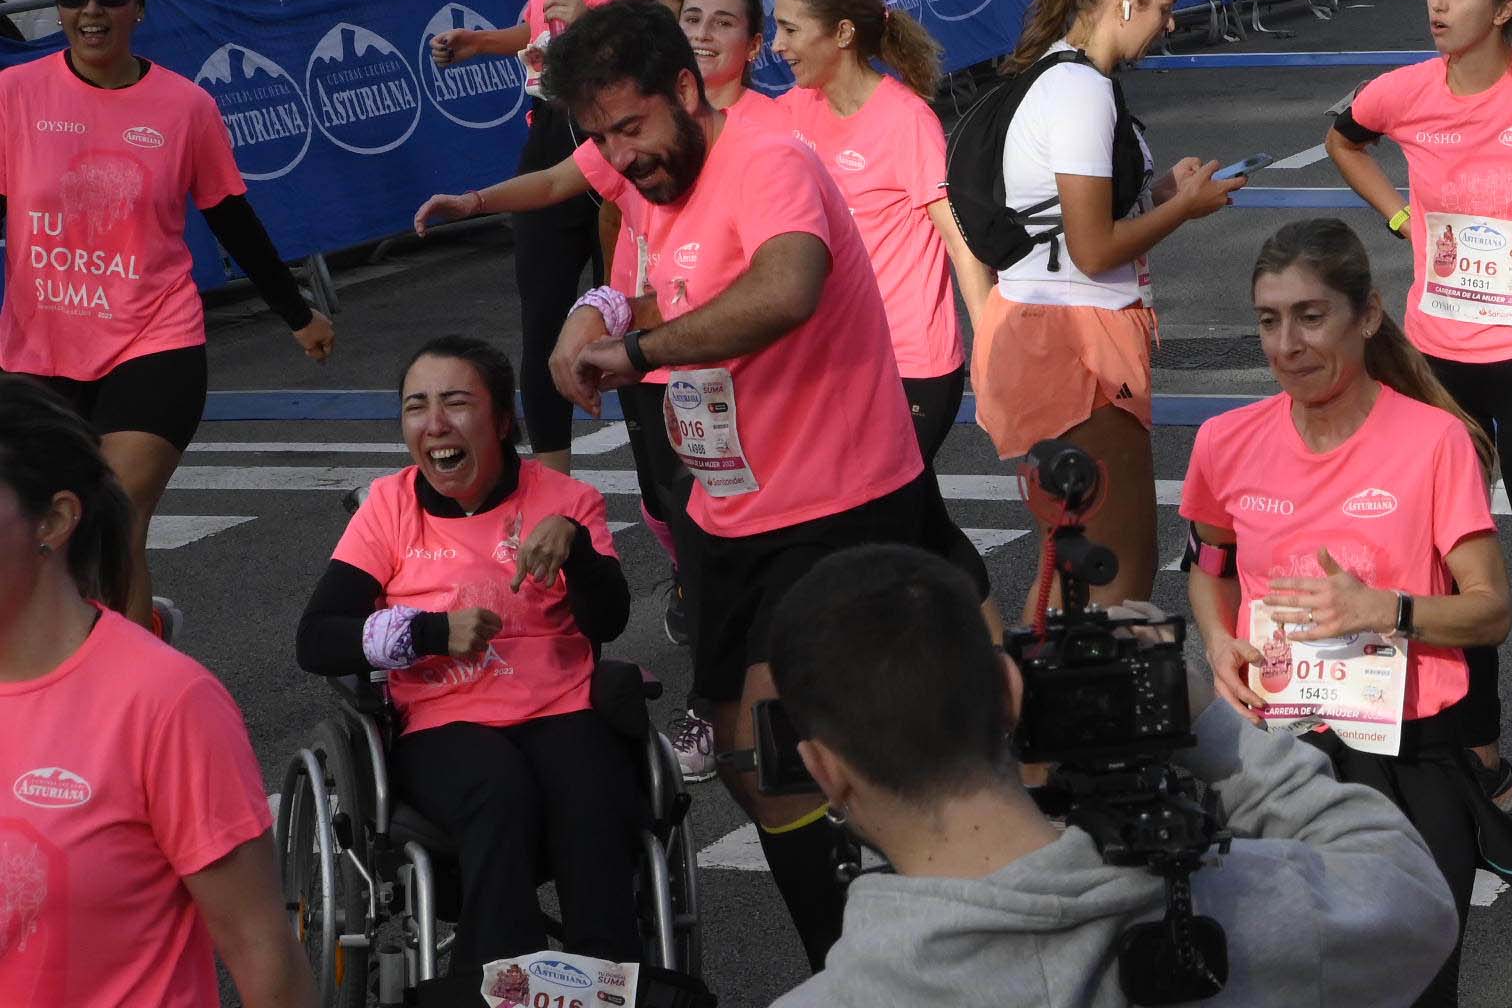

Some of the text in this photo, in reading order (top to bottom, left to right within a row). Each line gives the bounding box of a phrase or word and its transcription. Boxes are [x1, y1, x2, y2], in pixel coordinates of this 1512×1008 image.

[428, 54, 521, 102] ASTURIANA
[316, 78, 417, 128] ASTURIANA
[36, 120, 86, 134] OYSHO
[222, 101, 306, 149] STURIANA
[1416, 131, 1461, 144] OYSHO
[28, 210, 63, 236] TU
[1462, 232, 1503, 248] ASTURIANA
[31, 245, 140, 279] DORSAL
[1459, 257, 1497, 276] 016
[1460, 277, 1490, 290] 31631
[34, 278, 110, 310] SUMA
[680, 420, 705, 438] 016
[1240, 495, 1295, 516] OYSHO
[1296, 659, 1346, 680] 016
[1299, 687, 1338, 701] 15435
[1264, 707, 1299, 716] CARRERA
[1326, 708, 1361, 719] MUJER
[1337, 728, 1387, 743] Santander
[19, 779, 85, 801] ASTURIANA
[534, 964, 588, 986] ASTURIANA
[597, 976, 625, 987] SUMA
